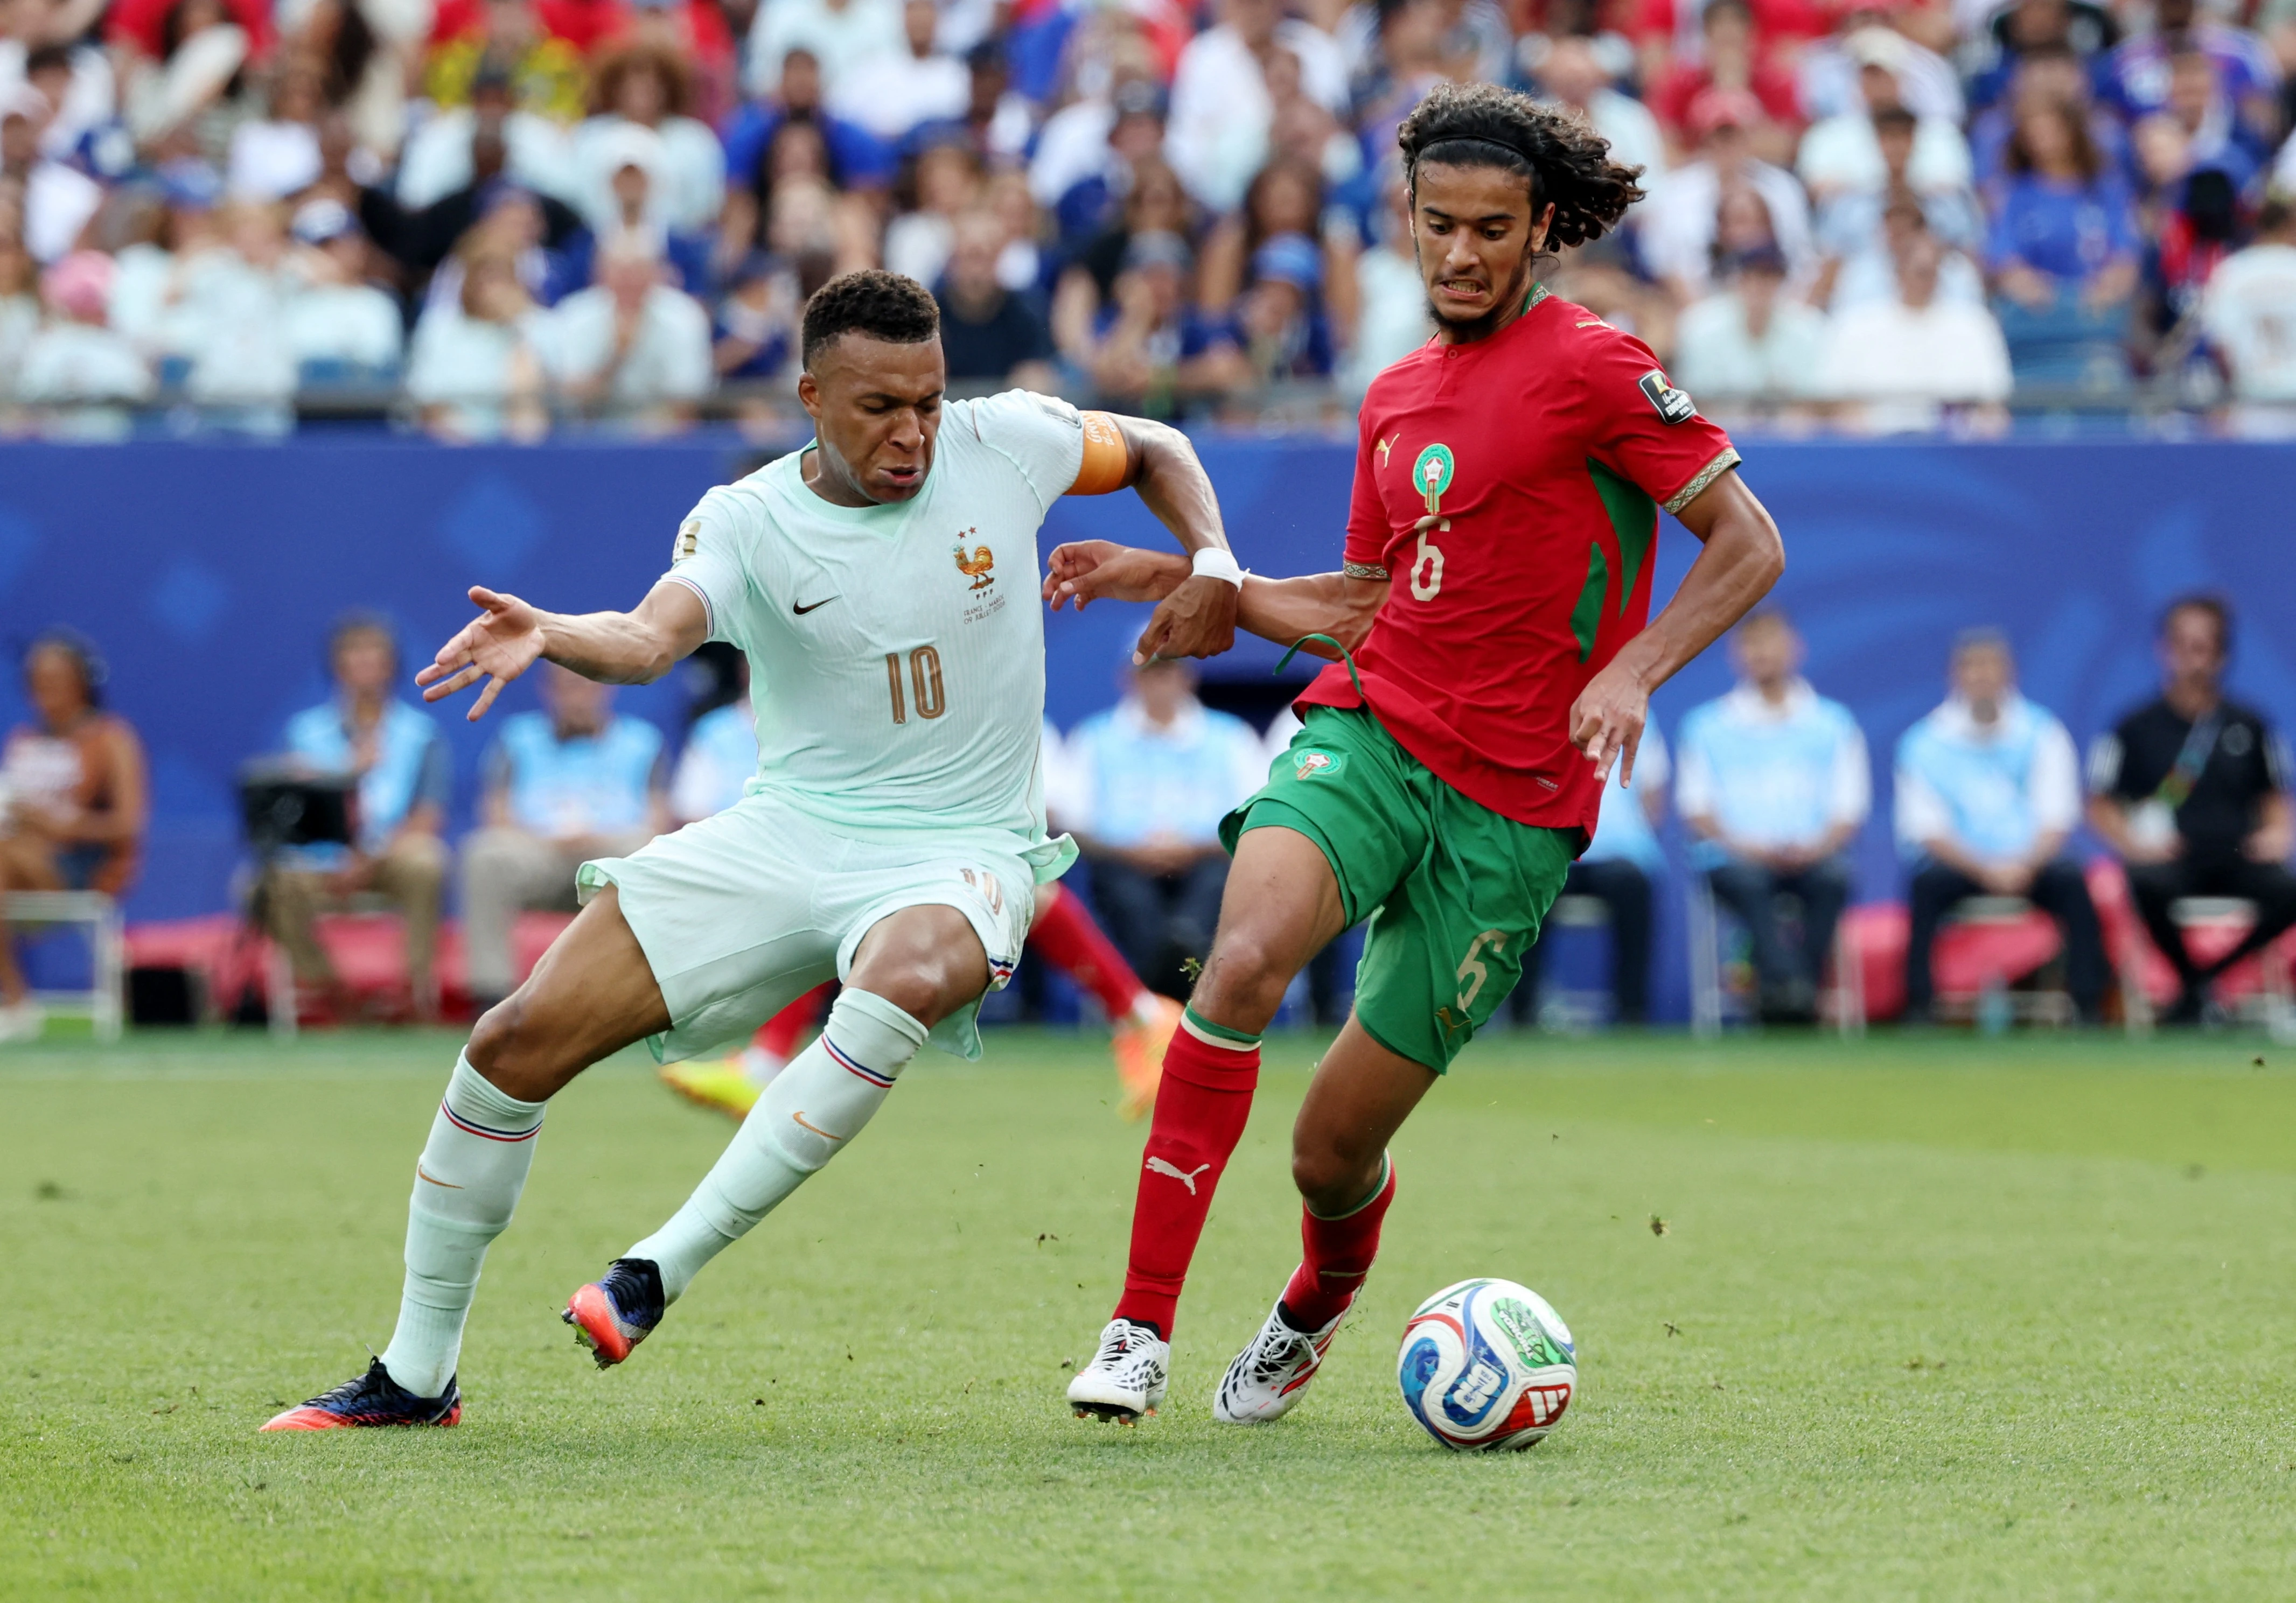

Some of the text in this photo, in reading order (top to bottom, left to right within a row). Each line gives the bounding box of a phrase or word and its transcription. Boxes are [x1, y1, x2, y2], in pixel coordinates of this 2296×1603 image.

[1411, 515, 1450, 601] 6
[964, 605, 982, 616] FRANCE
[885, 645, 945, 724] 10
[1457, 928, 1509, 1012] 6
[1498, 1310, 1533, 1360] TRIONDA
